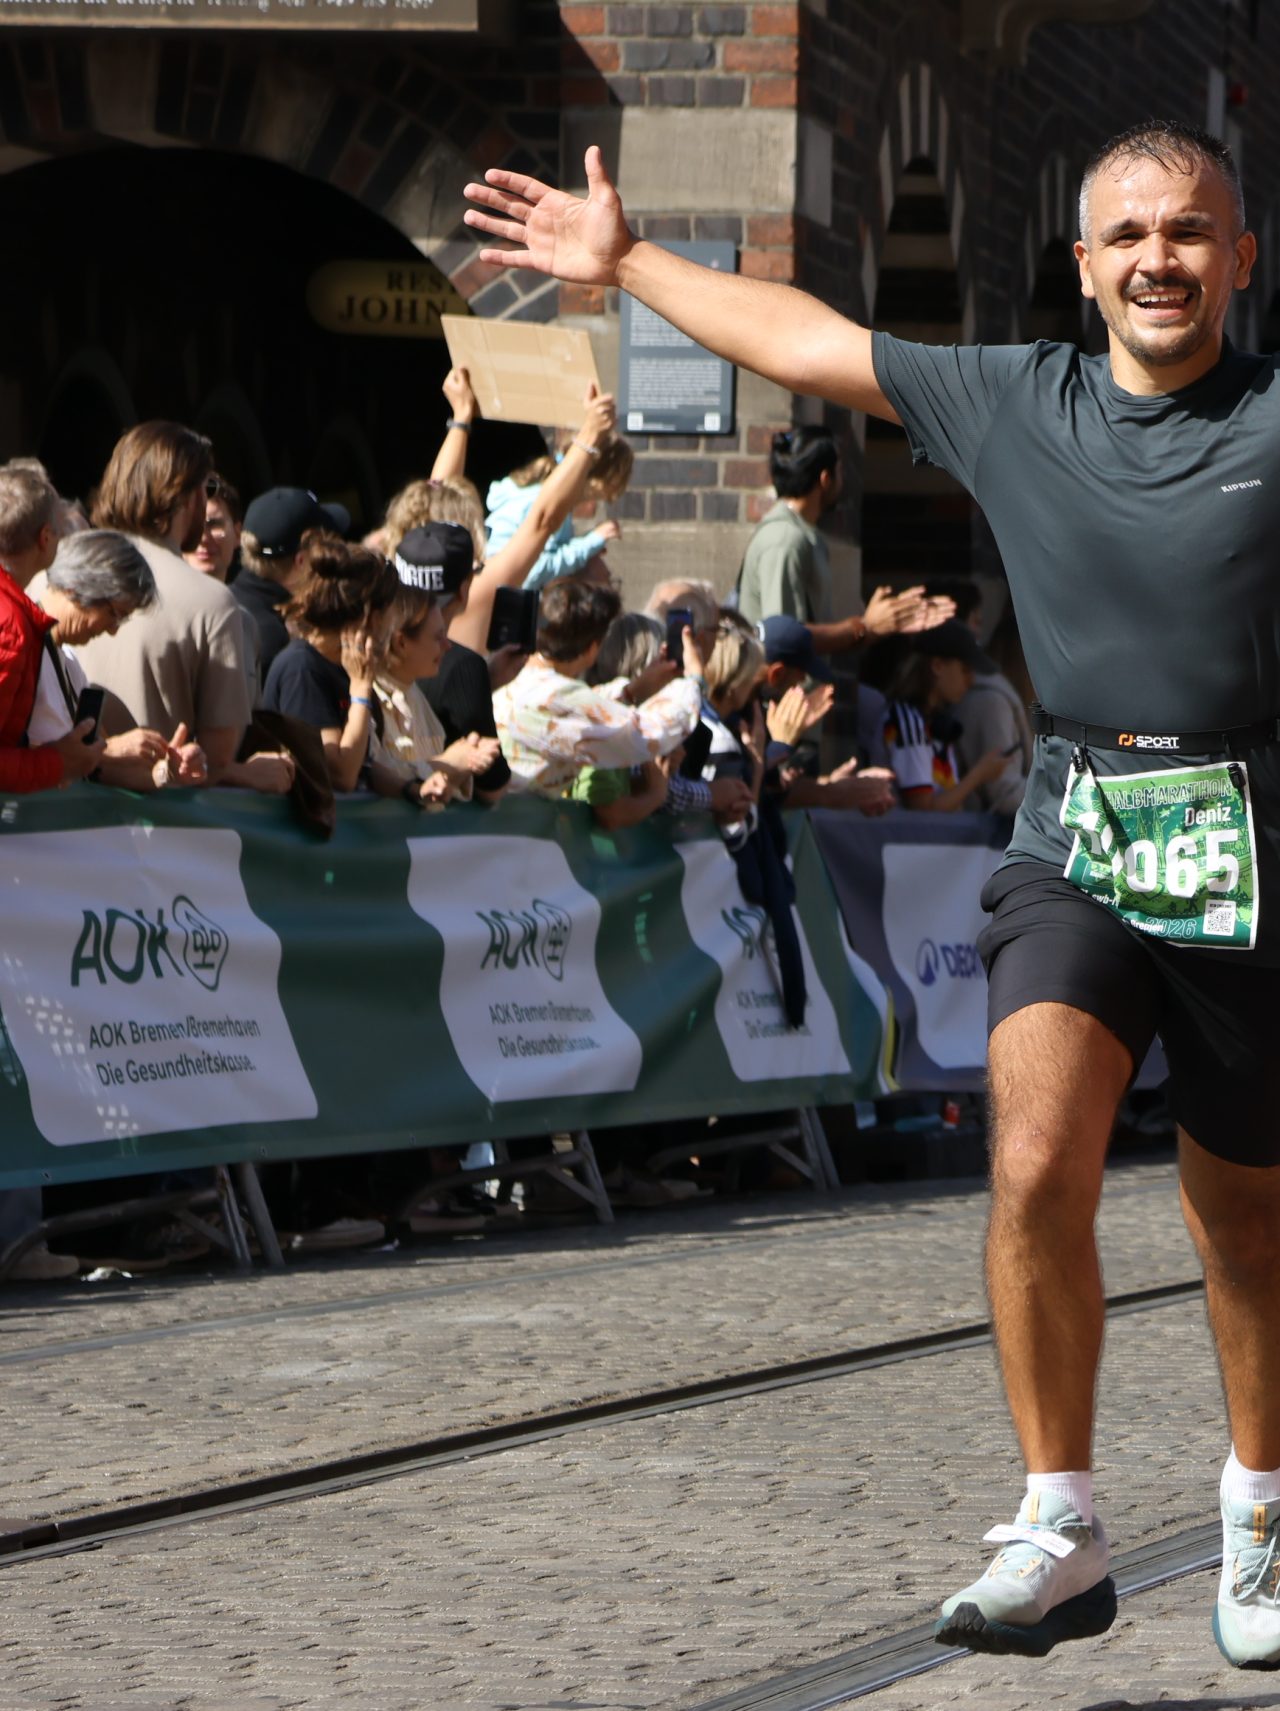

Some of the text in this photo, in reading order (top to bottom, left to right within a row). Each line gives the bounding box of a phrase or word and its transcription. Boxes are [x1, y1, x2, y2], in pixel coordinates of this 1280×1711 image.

[387, 270, 456, 293] RES
[1221, 479, 1262, 493] KIPRUN
[1184, 802, 1232, 827] Deniz
[71, 908, 184, 987] AOK
[489, 1002, 514, 1025] AOK
[89, 1014, 261, 1049] AOK Bremen/Bremerhaven
[498, 1036, 516, 1058] Die
[96, 1051, 257, 1086] Die Gesundheitskasse.
